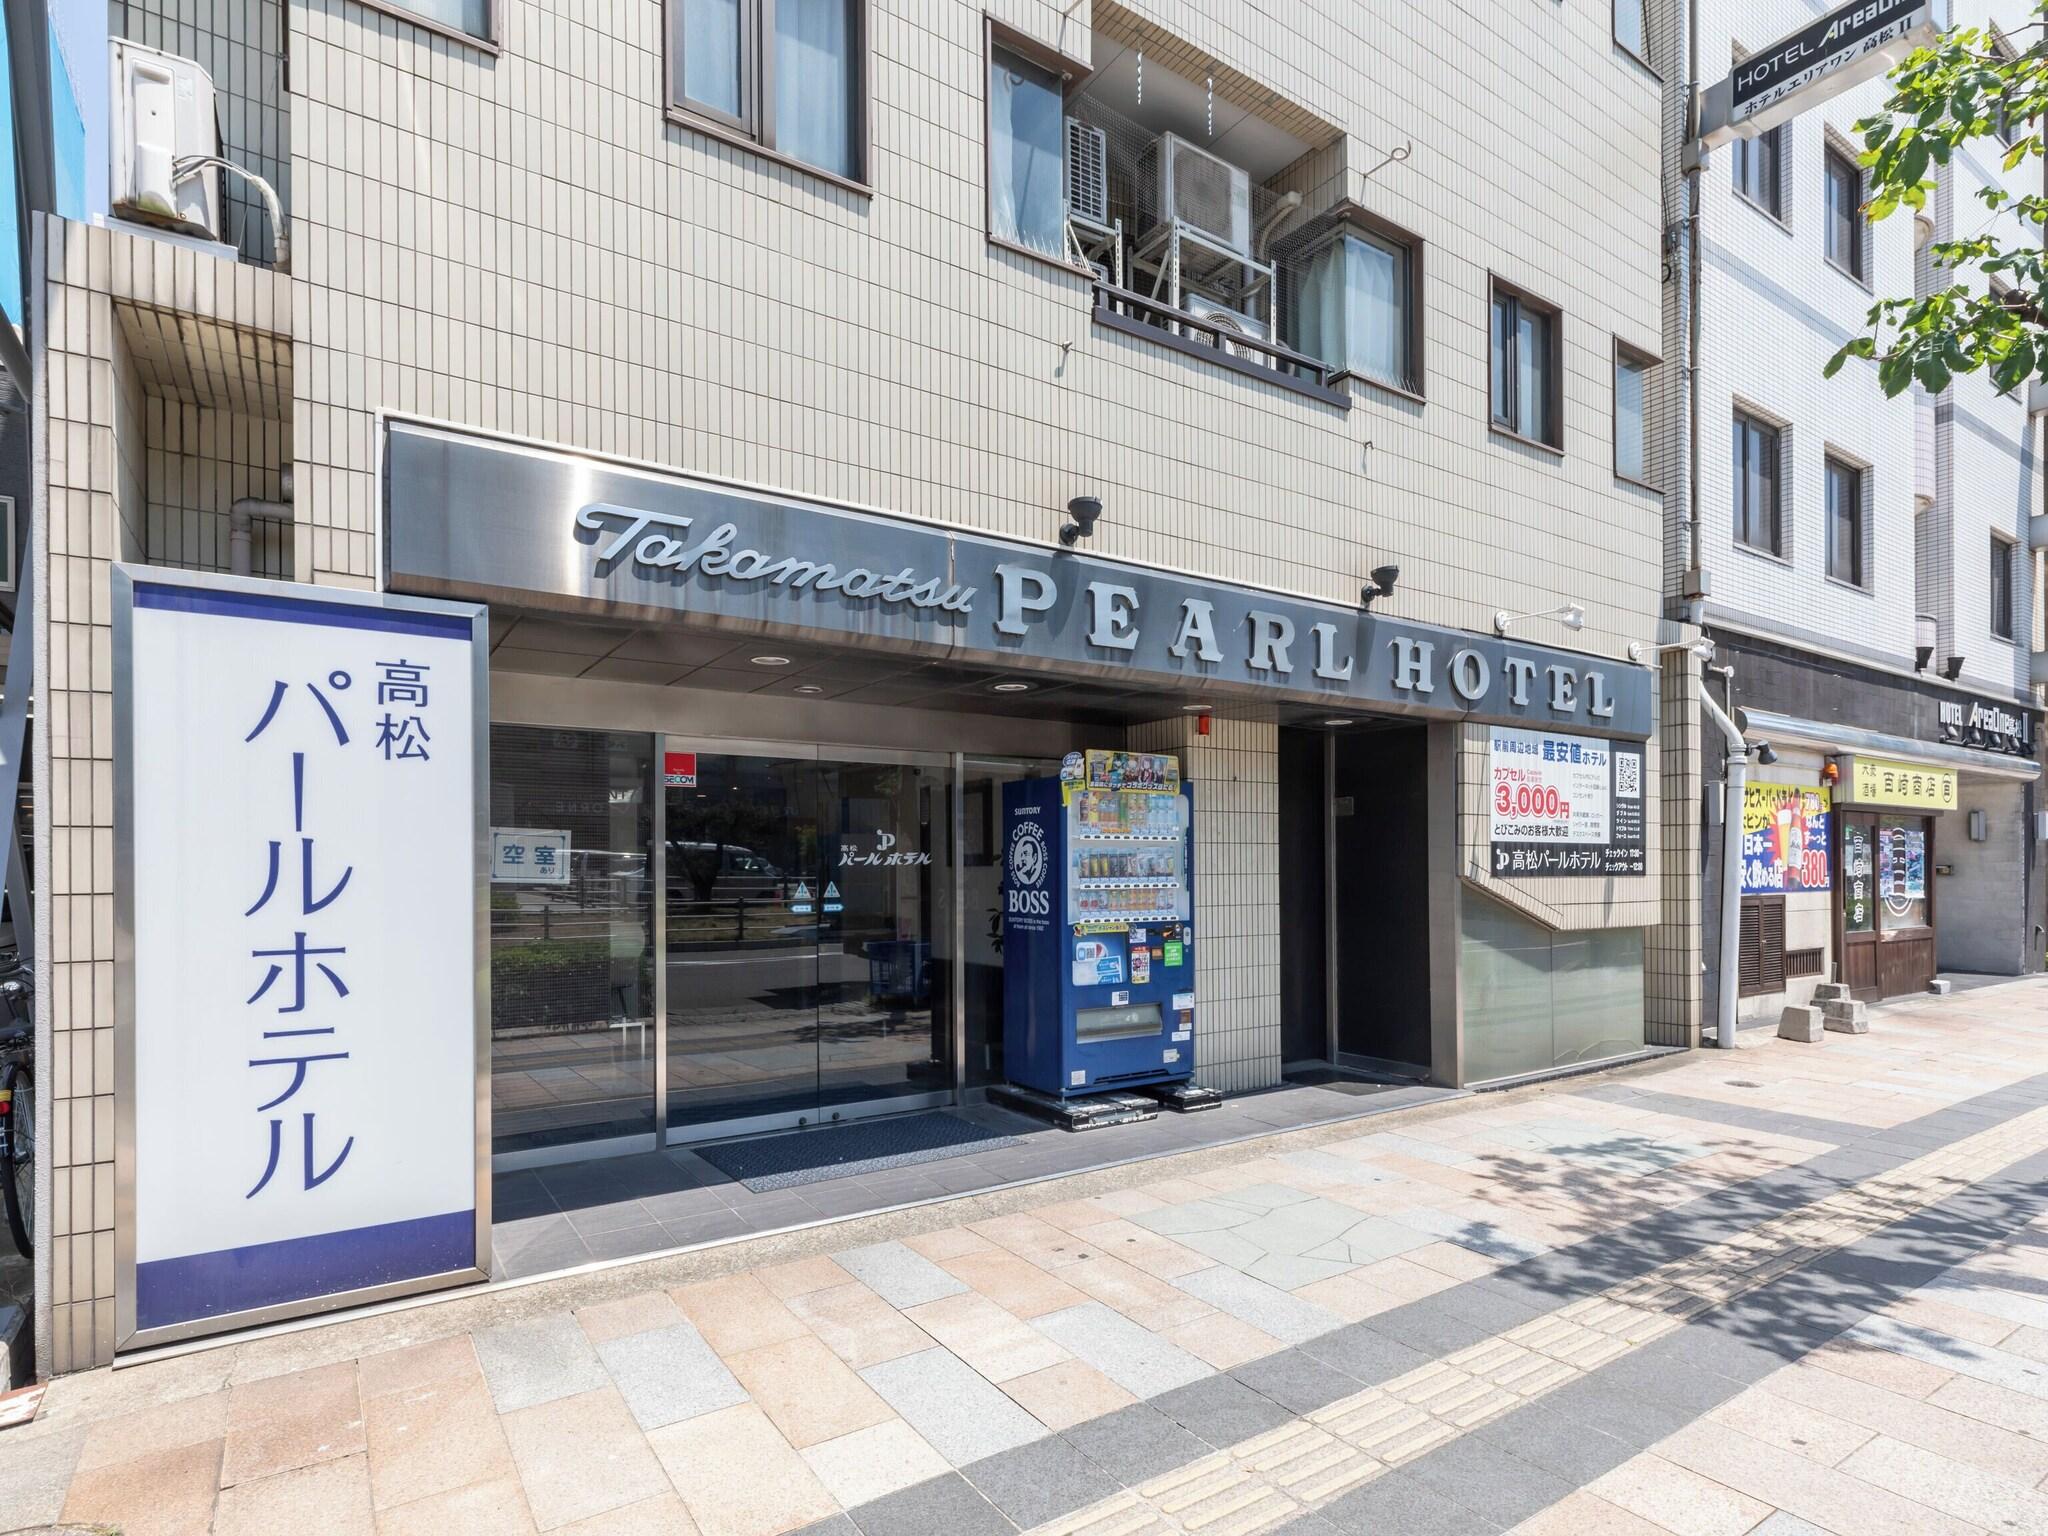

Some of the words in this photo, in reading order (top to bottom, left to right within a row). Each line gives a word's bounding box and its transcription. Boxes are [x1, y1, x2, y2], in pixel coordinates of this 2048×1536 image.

[1738, 42, 1814, 92] HOTEL
[1744, 50, 1857, 115] ホテルエリアワン
[1863, 26, 1894, 53] 高松
[576, 503, 978, 613] Takamatsu
[995, 563, 1353, 681] PEARL
[1393, 635, 1616, 718] HOTEL
[375, 659, 430, 761] 高松
[1940, 702, 1963, 727] HOTEL
[1543, 740, 1607, 767] 最安値ホテル
[1494, 768, 1526, 782] カプセル
[1014, 806, 1040, 816] SUNTORY
[1496, 784, 1570, 819] 3,000円
[1012, 821, 1044, 841] COFFEE
[1494, 823, 1569, 838] とびこみのお客様大歓迎
[1744, 834, 1773, 856] 日本一
[838, 852, 933, 867] パールホテル
[1512, 850, 1601, 871] 高松パールホテル
[1008, 890, 1050, 915] BOSS
[244, 670, 354, 1200] パールホテル
